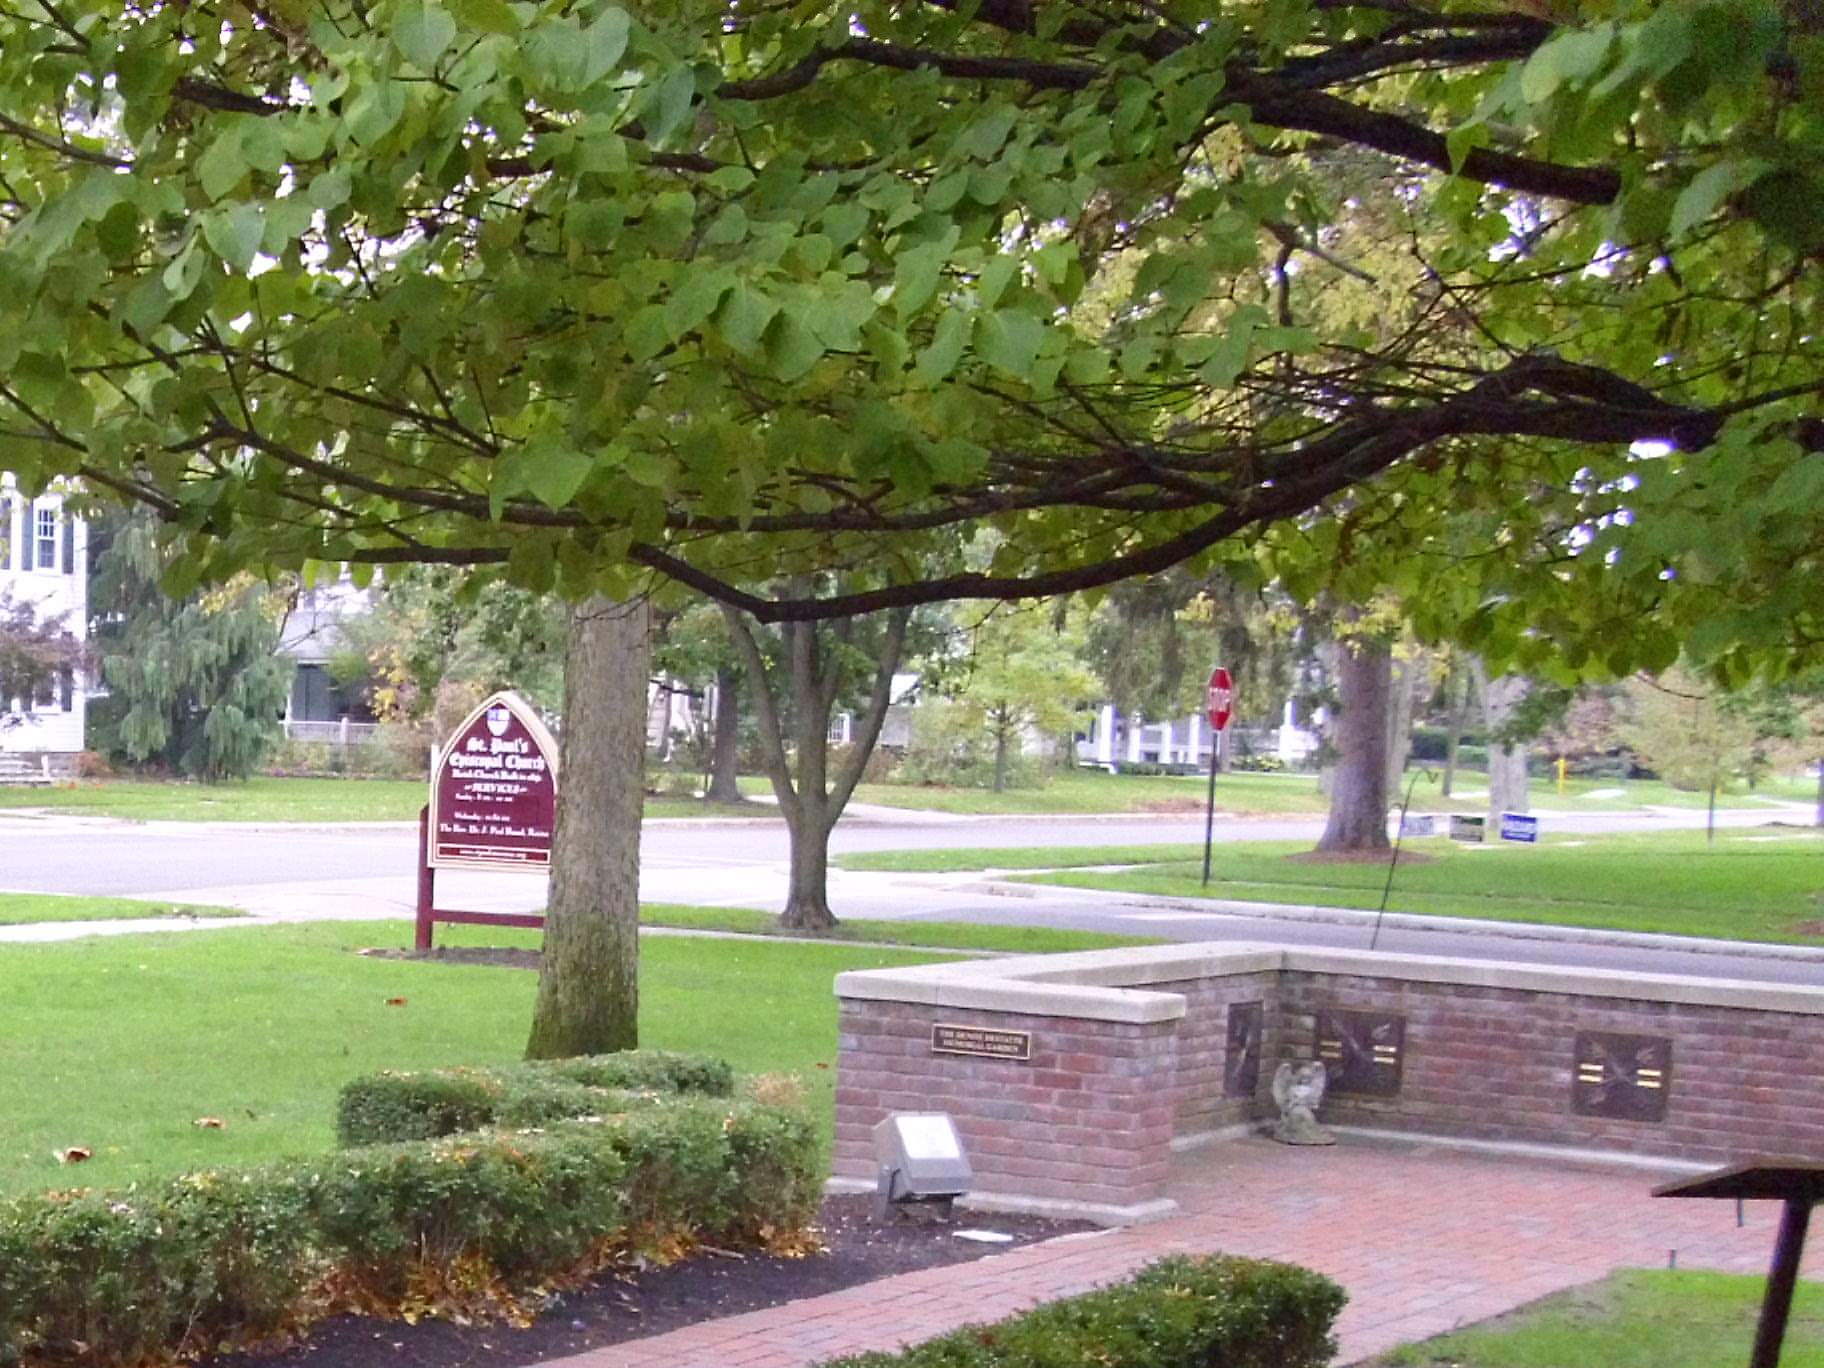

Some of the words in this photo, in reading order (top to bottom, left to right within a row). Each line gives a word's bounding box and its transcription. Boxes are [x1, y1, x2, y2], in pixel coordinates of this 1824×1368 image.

[1207, 687, 1231, 712] STOP
[466, 737, 488, 752] St.
[489, 737, 529, 754] Paul's
[448, 752, 503, 769] Episcopal
[504, 754, 545, 772] Church
[472, 783, 520, 794] SERVICES
